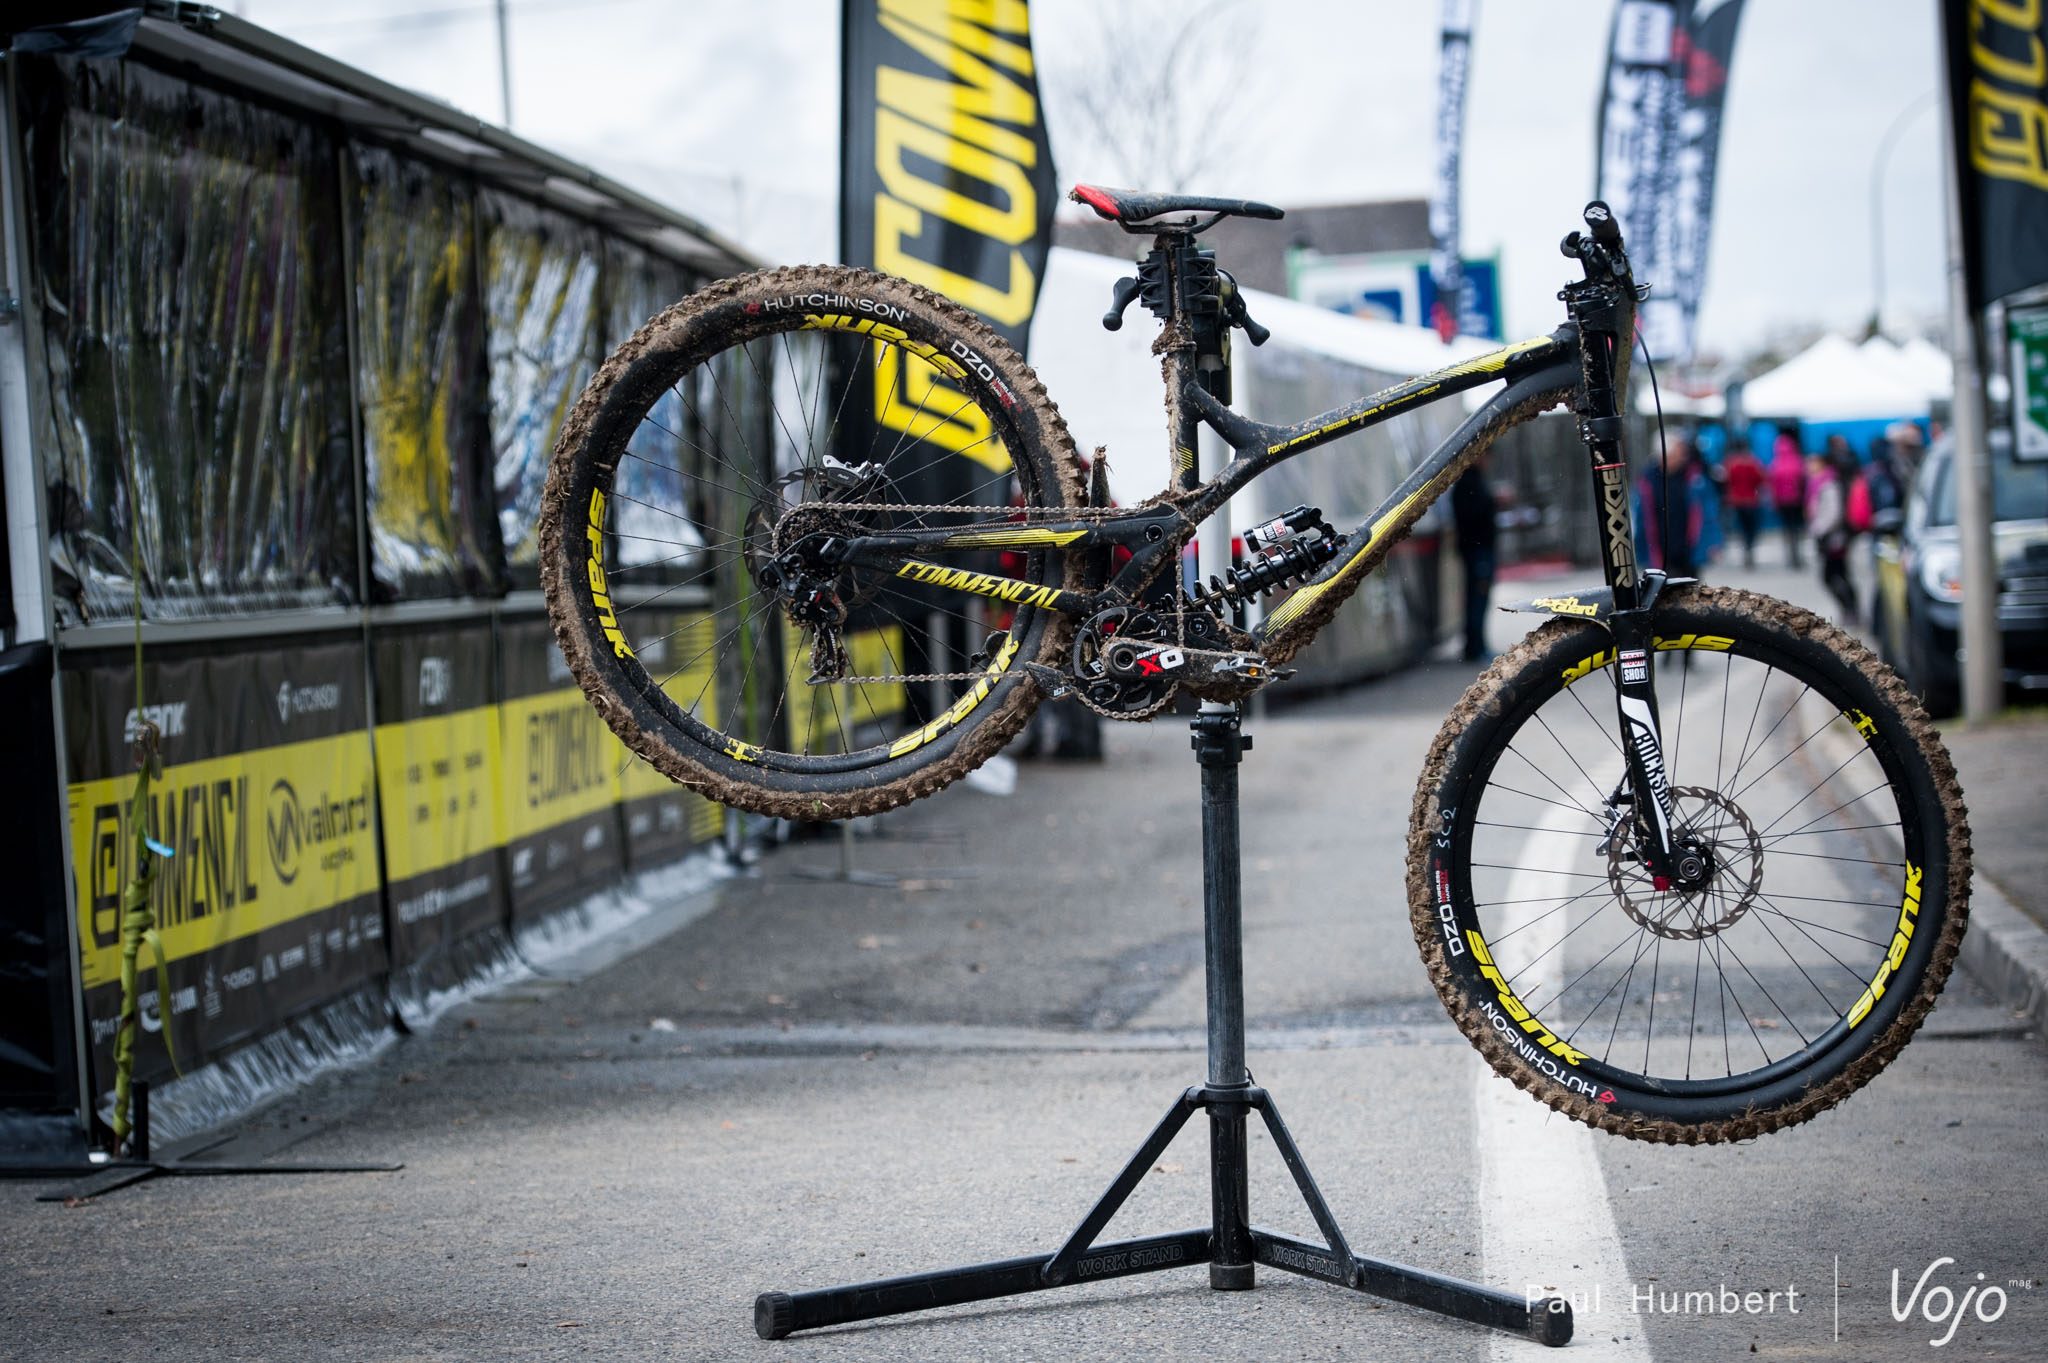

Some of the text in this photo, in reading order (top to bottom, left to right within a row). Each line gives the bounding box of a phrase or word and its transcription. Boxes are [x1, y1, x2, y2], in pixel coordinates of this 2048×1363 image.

[764, 294, 905, 322] HUTCHINSON
[950, 340, 994, 381] DZO
[896, 561, 1064, 611] COMMENCAL
[1623, 668, 1646, 682] SHOX
[1435, 870, 1444, 904] TUBELESS
[1440, 904, 1465, 957] DZO
[1481, 1001, 1598, 1098] HUTCHINSON
[1076, 1244, 1184, 1277] WORK STAND
[1271, 1244, 1342, 1279] WORK STAND
